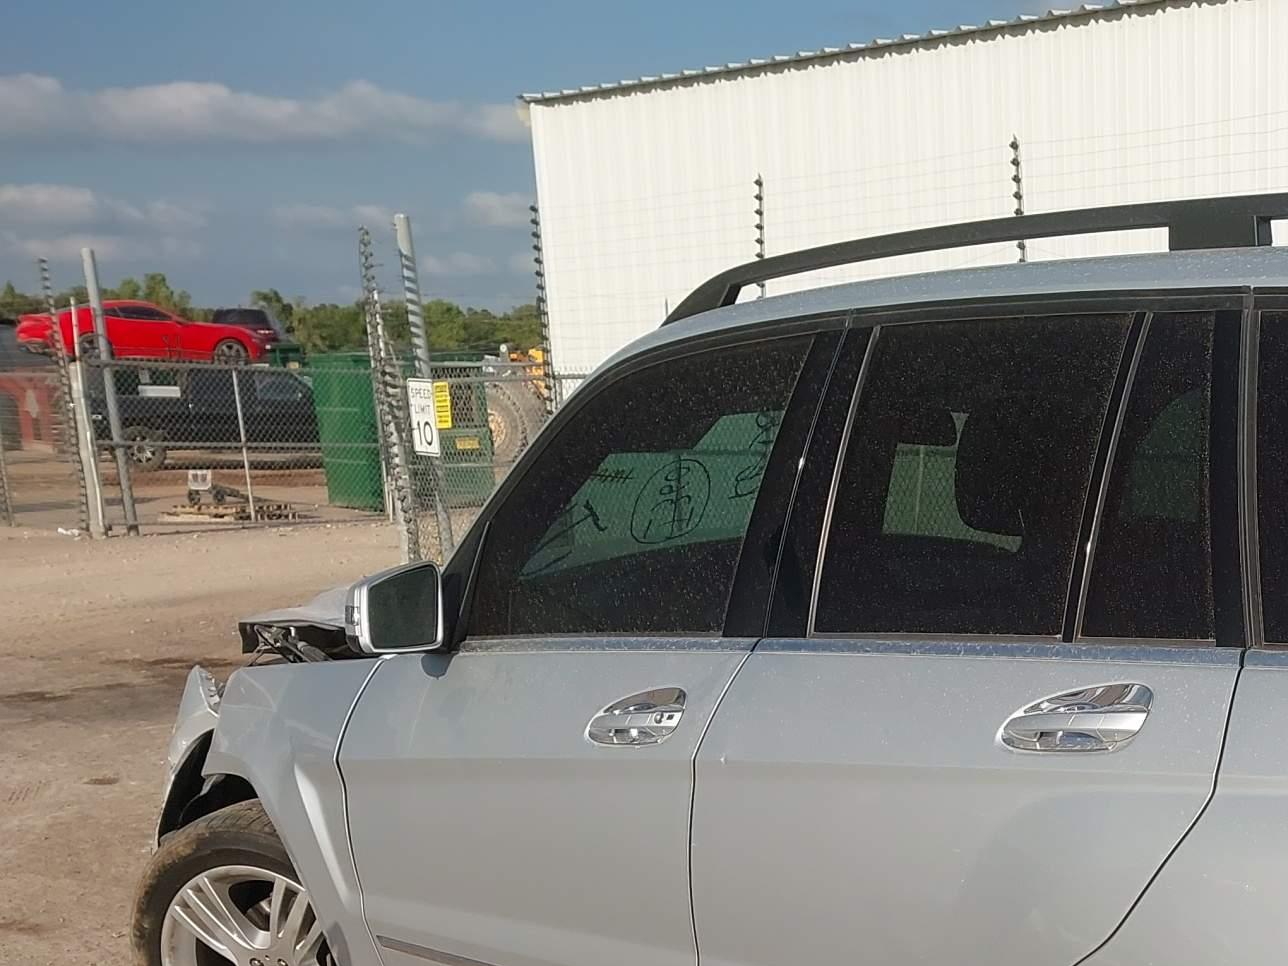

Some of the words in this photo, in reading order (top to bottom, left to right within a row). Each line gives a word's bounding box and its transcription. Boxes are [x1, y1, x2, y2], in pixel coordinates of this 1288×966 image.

[410, 387, 432, 400] SPEED
[414, 404, 431, 414] LIMIT
[417, 420, 434, 447] 10
